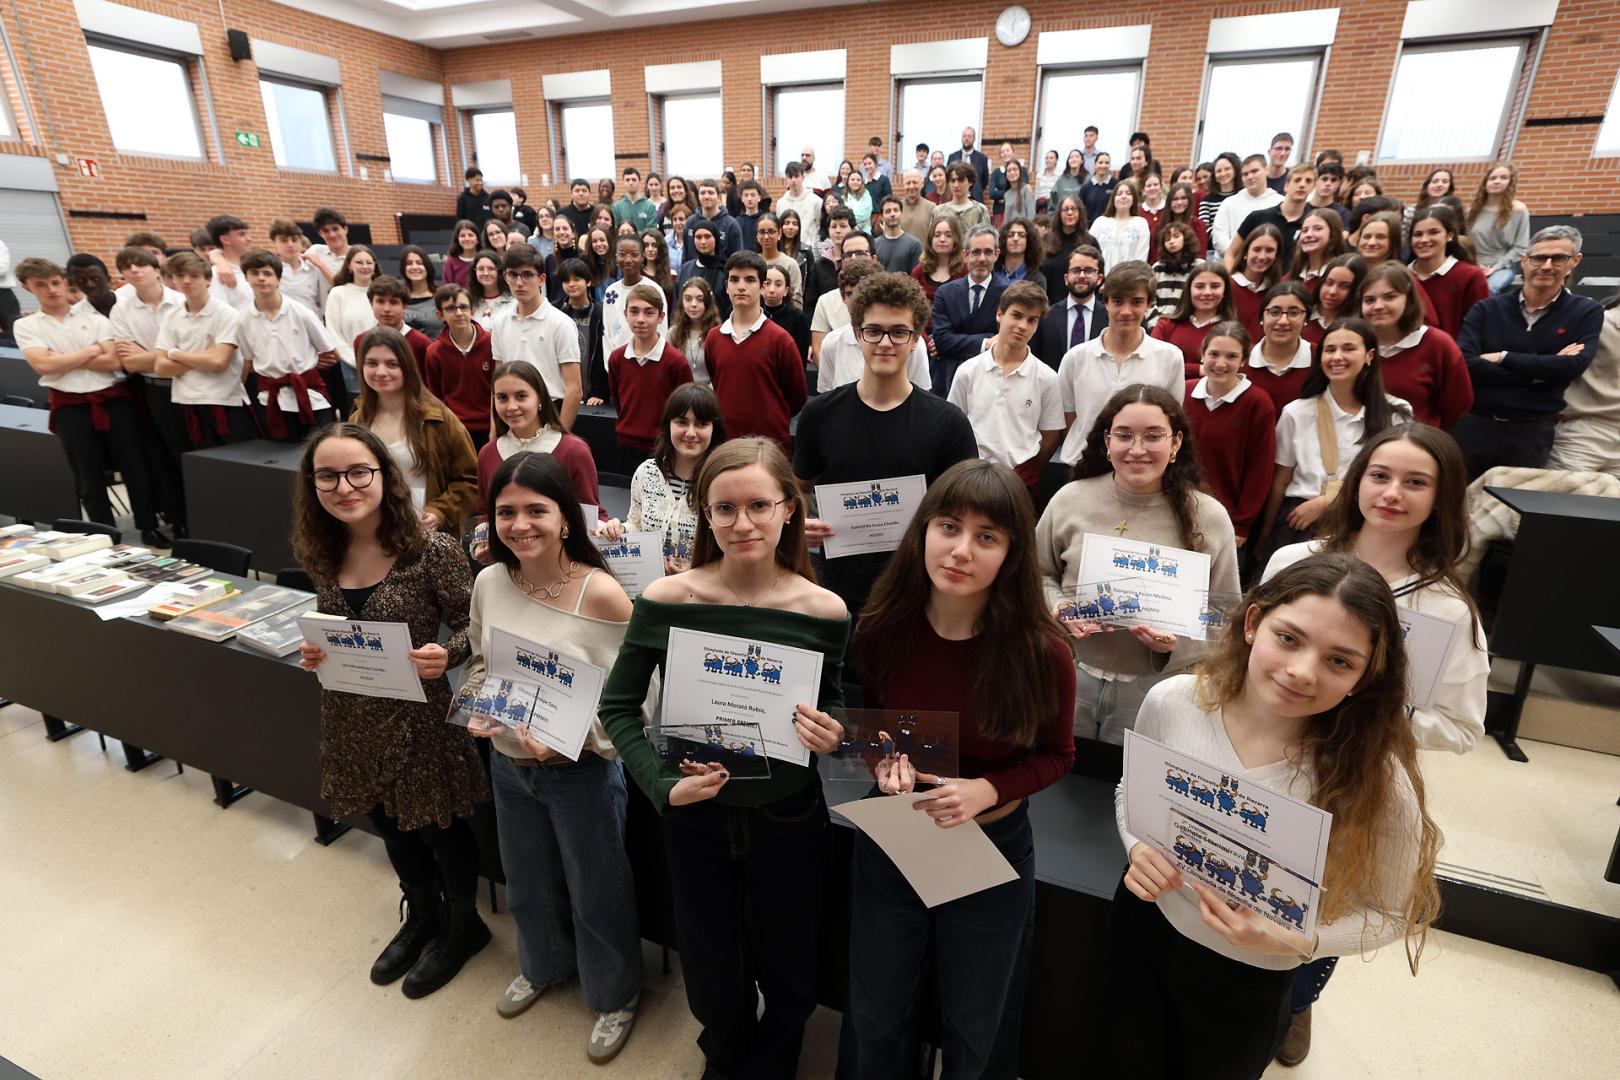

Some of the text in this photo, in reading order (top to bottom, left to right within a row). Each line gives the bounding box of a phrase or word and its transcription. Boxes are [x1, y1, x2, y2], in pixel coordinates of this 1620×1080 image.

[711, 698, 727, 707] Laura
[727, 701, 748, 711] Morató
[715, 715, 736, 726] PRIMER
[1246, 796, 1269, 809] Navarra
